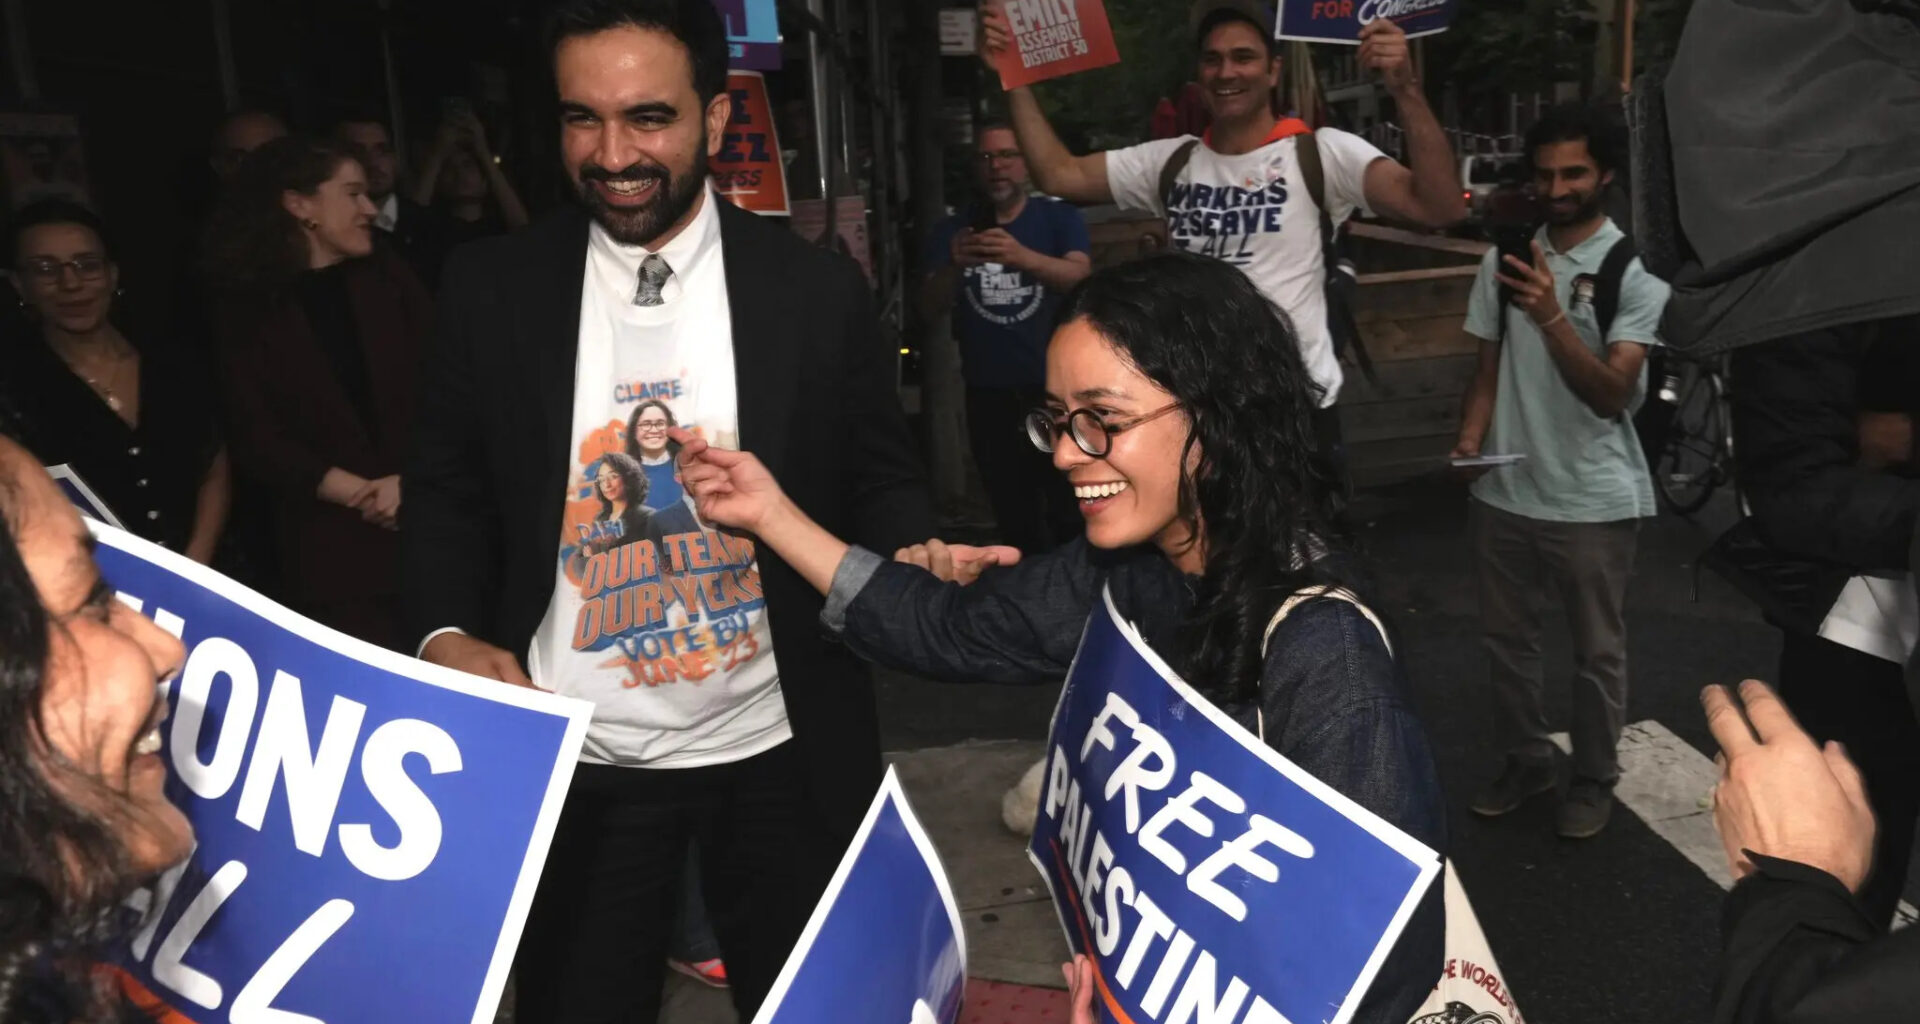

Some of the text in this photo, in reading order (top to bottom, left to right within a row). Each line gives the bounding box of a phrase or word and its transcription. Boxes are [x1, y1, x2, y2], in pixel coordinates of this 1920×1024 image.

[1003, 0, 1078, 35] EMILY
[1311, 2, 1354, 20] FOR
[1017, 21, 1082, 52] ASSEMBLY
[1021, 38, 1088, 68] DISTRICT 50
[717, 132, 770, 163] EZ
[580, 539, 661, 600] OUR
[572, 583, 665, 652] OUR
[617, 633, 759, 689] JUNE 23
[619, 624, 706, 662] VOTE
[1080, 691, 1315, 922] FREE
